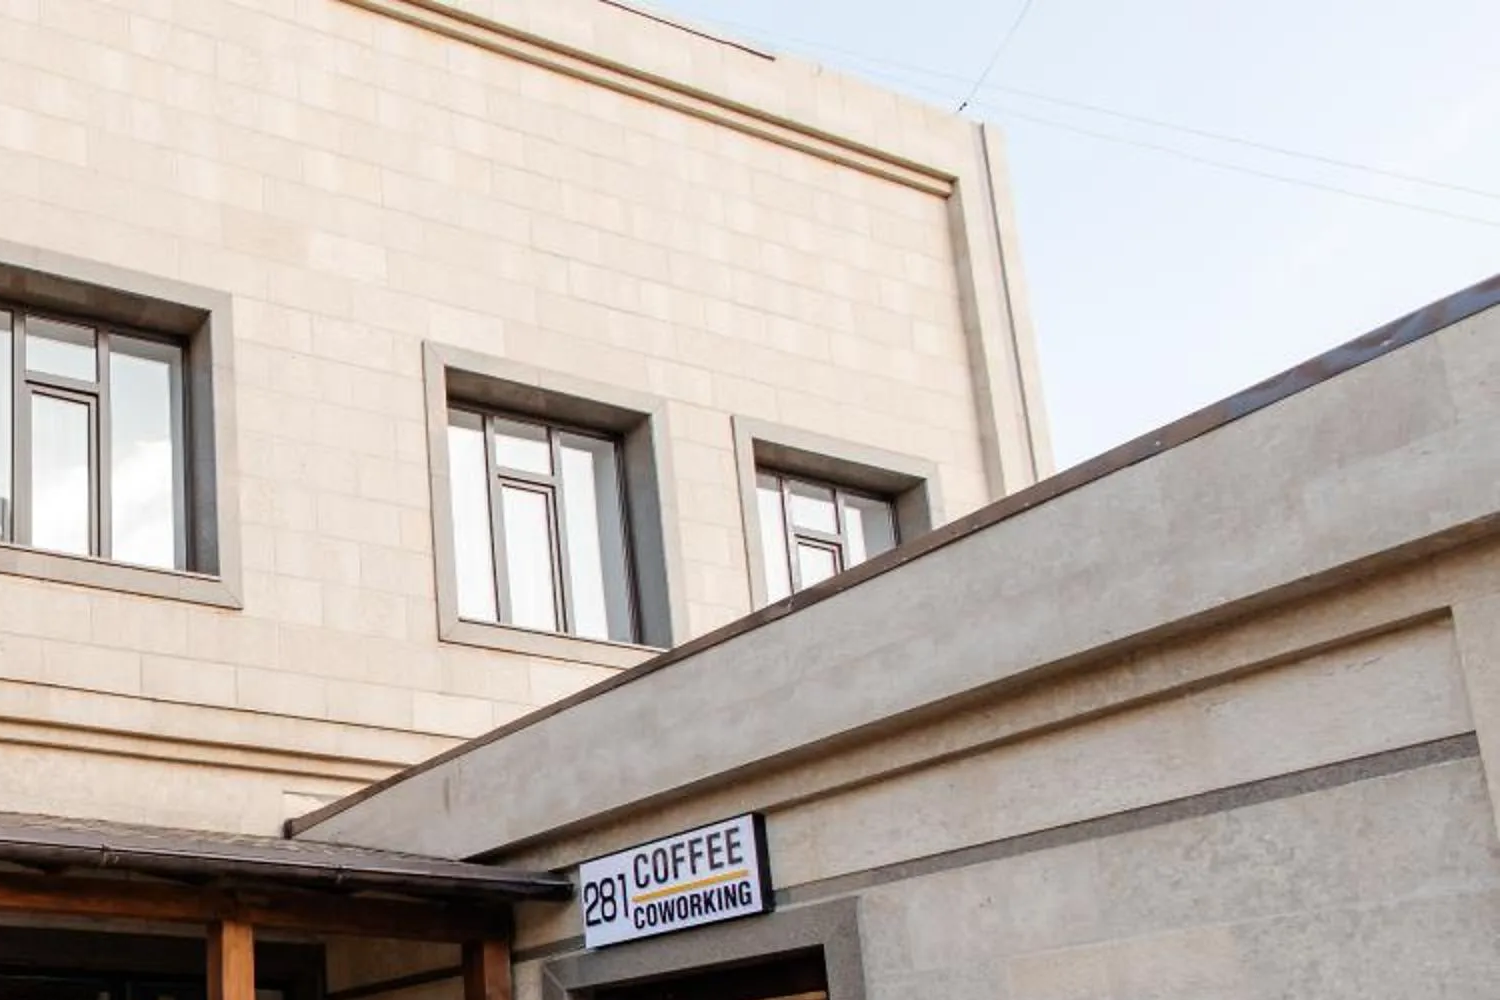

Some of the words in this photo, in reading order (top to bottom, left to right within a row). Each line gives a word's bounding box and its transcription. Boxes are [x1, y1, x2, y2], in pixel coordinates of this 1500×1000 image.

[633, 827, 743, 888] COFFEE
[583, 874, 629, 927] 281
[633, 881, 753, 930] COWORKING
